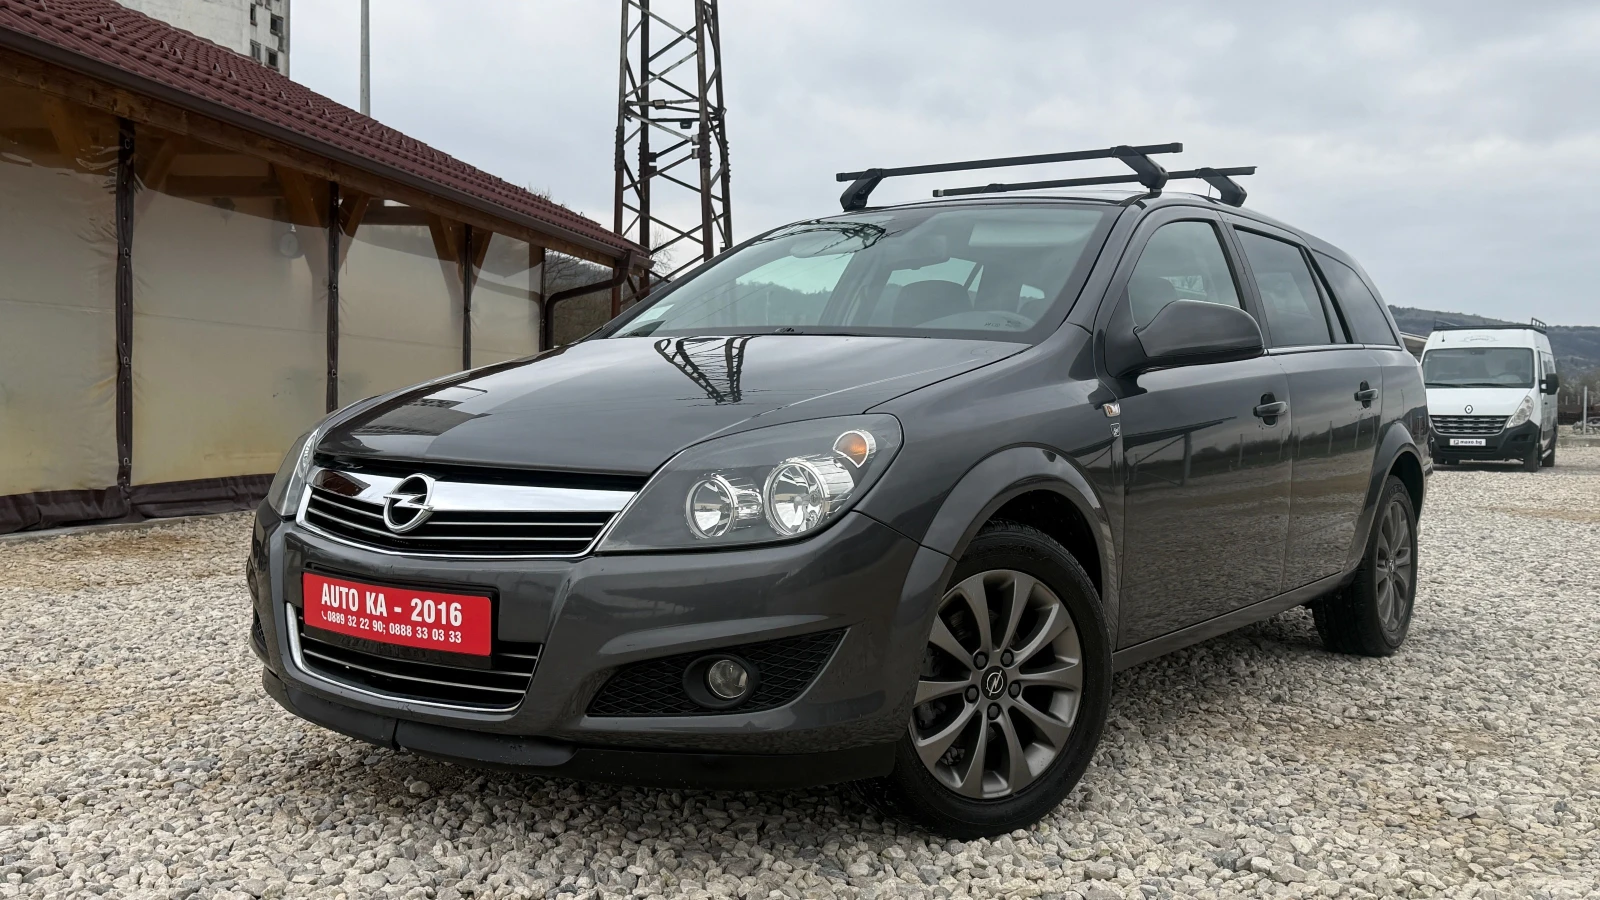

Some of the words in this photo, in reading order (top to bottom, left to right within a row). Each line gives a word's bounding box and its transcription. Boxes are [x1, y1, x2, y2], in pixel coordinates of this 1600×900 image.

[321, 582, 359, 612] AUTO
[365, 591, 388, 618] KA
[410, 597, 463, 627] 2016
[327, 610, 345, 625] 0889
[347, 615, 357, 628] 32
[359, 617, 370, 630] 22
[372, 620, 386, 635] 90;
[388, 622, 413, 637] 0888
[416, 626, 429, 639] 33
[431, 628, 445, 642] 03
[448, 631, 462, 644] 33
